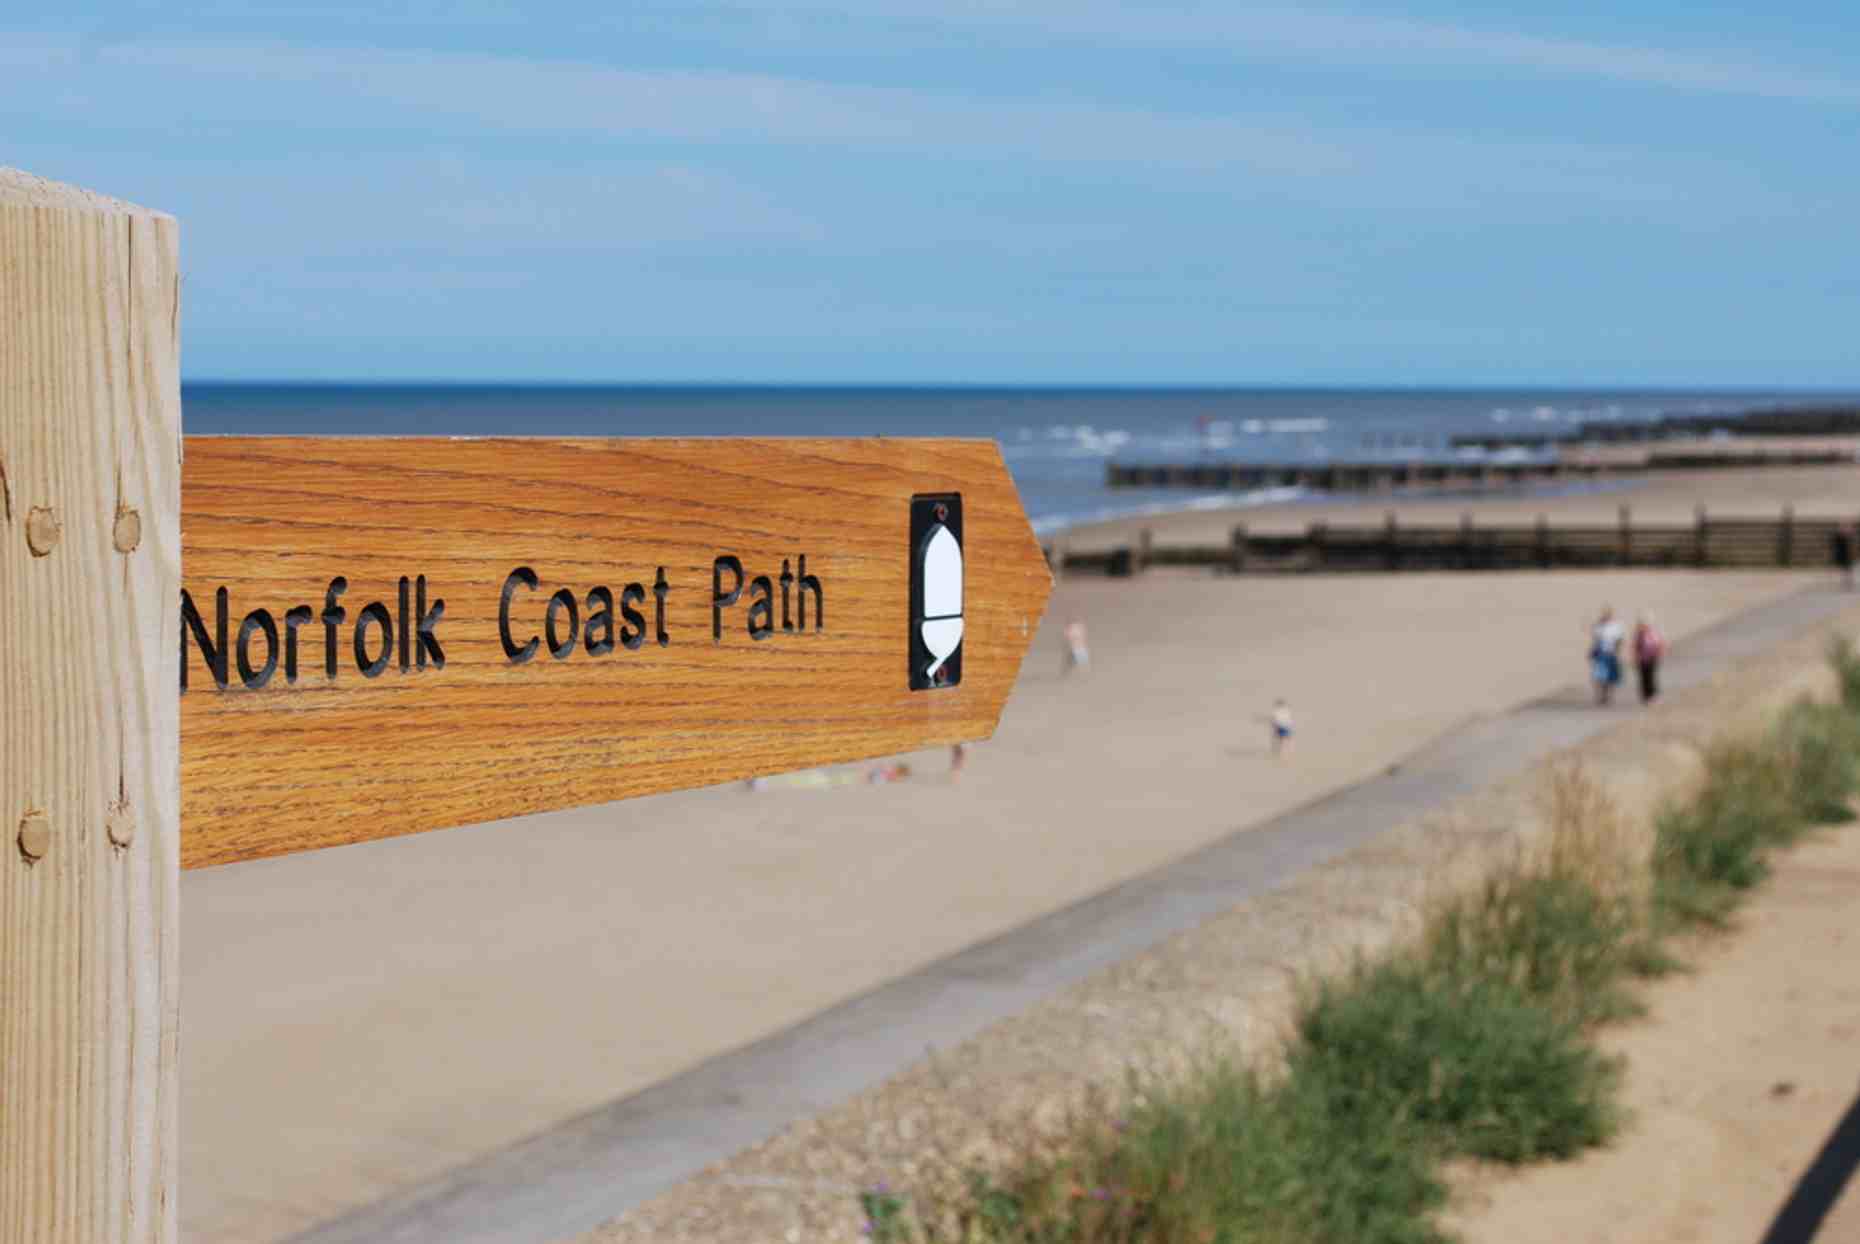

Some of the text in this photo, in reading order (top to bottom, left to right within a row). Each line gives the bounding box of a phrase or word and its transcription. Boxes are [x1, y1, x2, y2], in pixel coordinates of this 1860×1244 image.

[180, 553, 824, 695] Norfolk Coast Path
